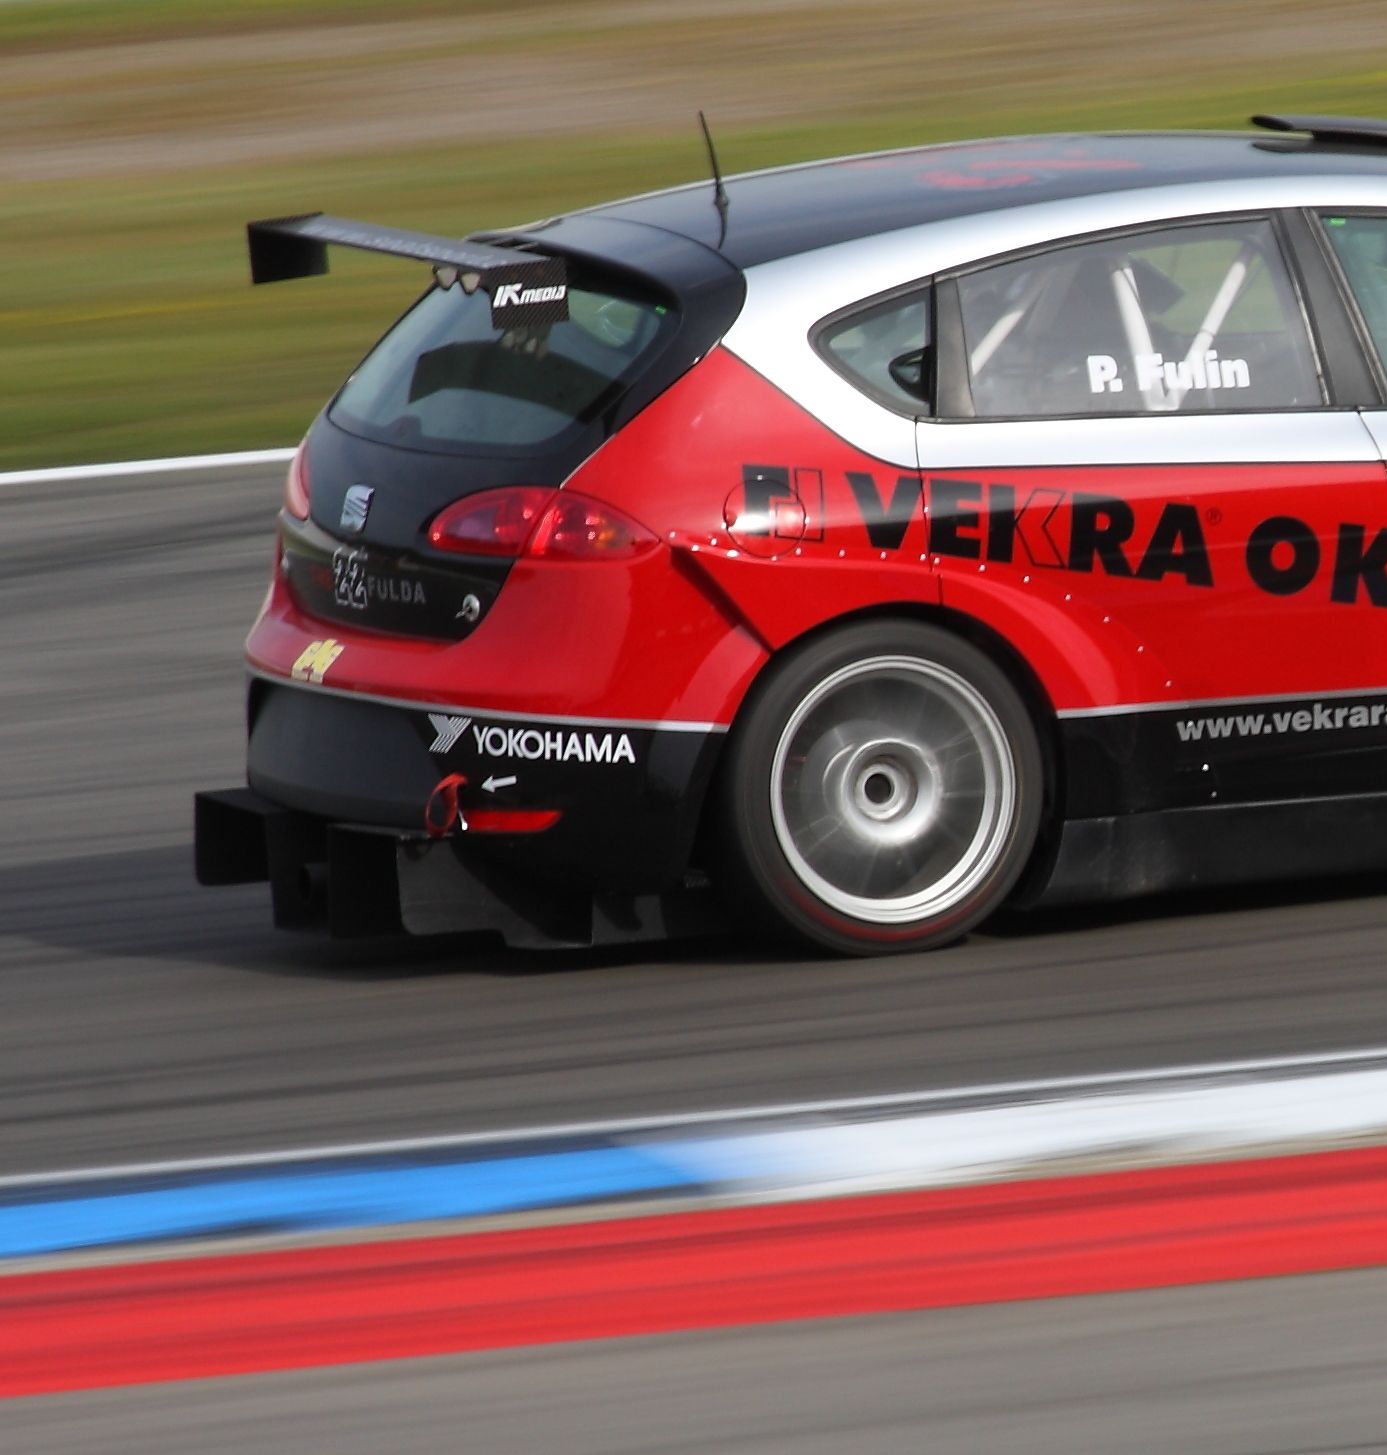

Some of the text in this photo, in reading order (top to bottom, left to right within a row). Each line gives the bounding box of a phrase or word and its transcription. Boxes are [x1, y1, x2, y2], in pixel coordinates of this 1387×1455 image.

[1087, 350, 1250, 393] P. Fulin
[845, 472, 1215, 588] VEKRA
[366, 575, 427, 604] FULDA
[472, 725, 637, 764] YOKOHAMA
